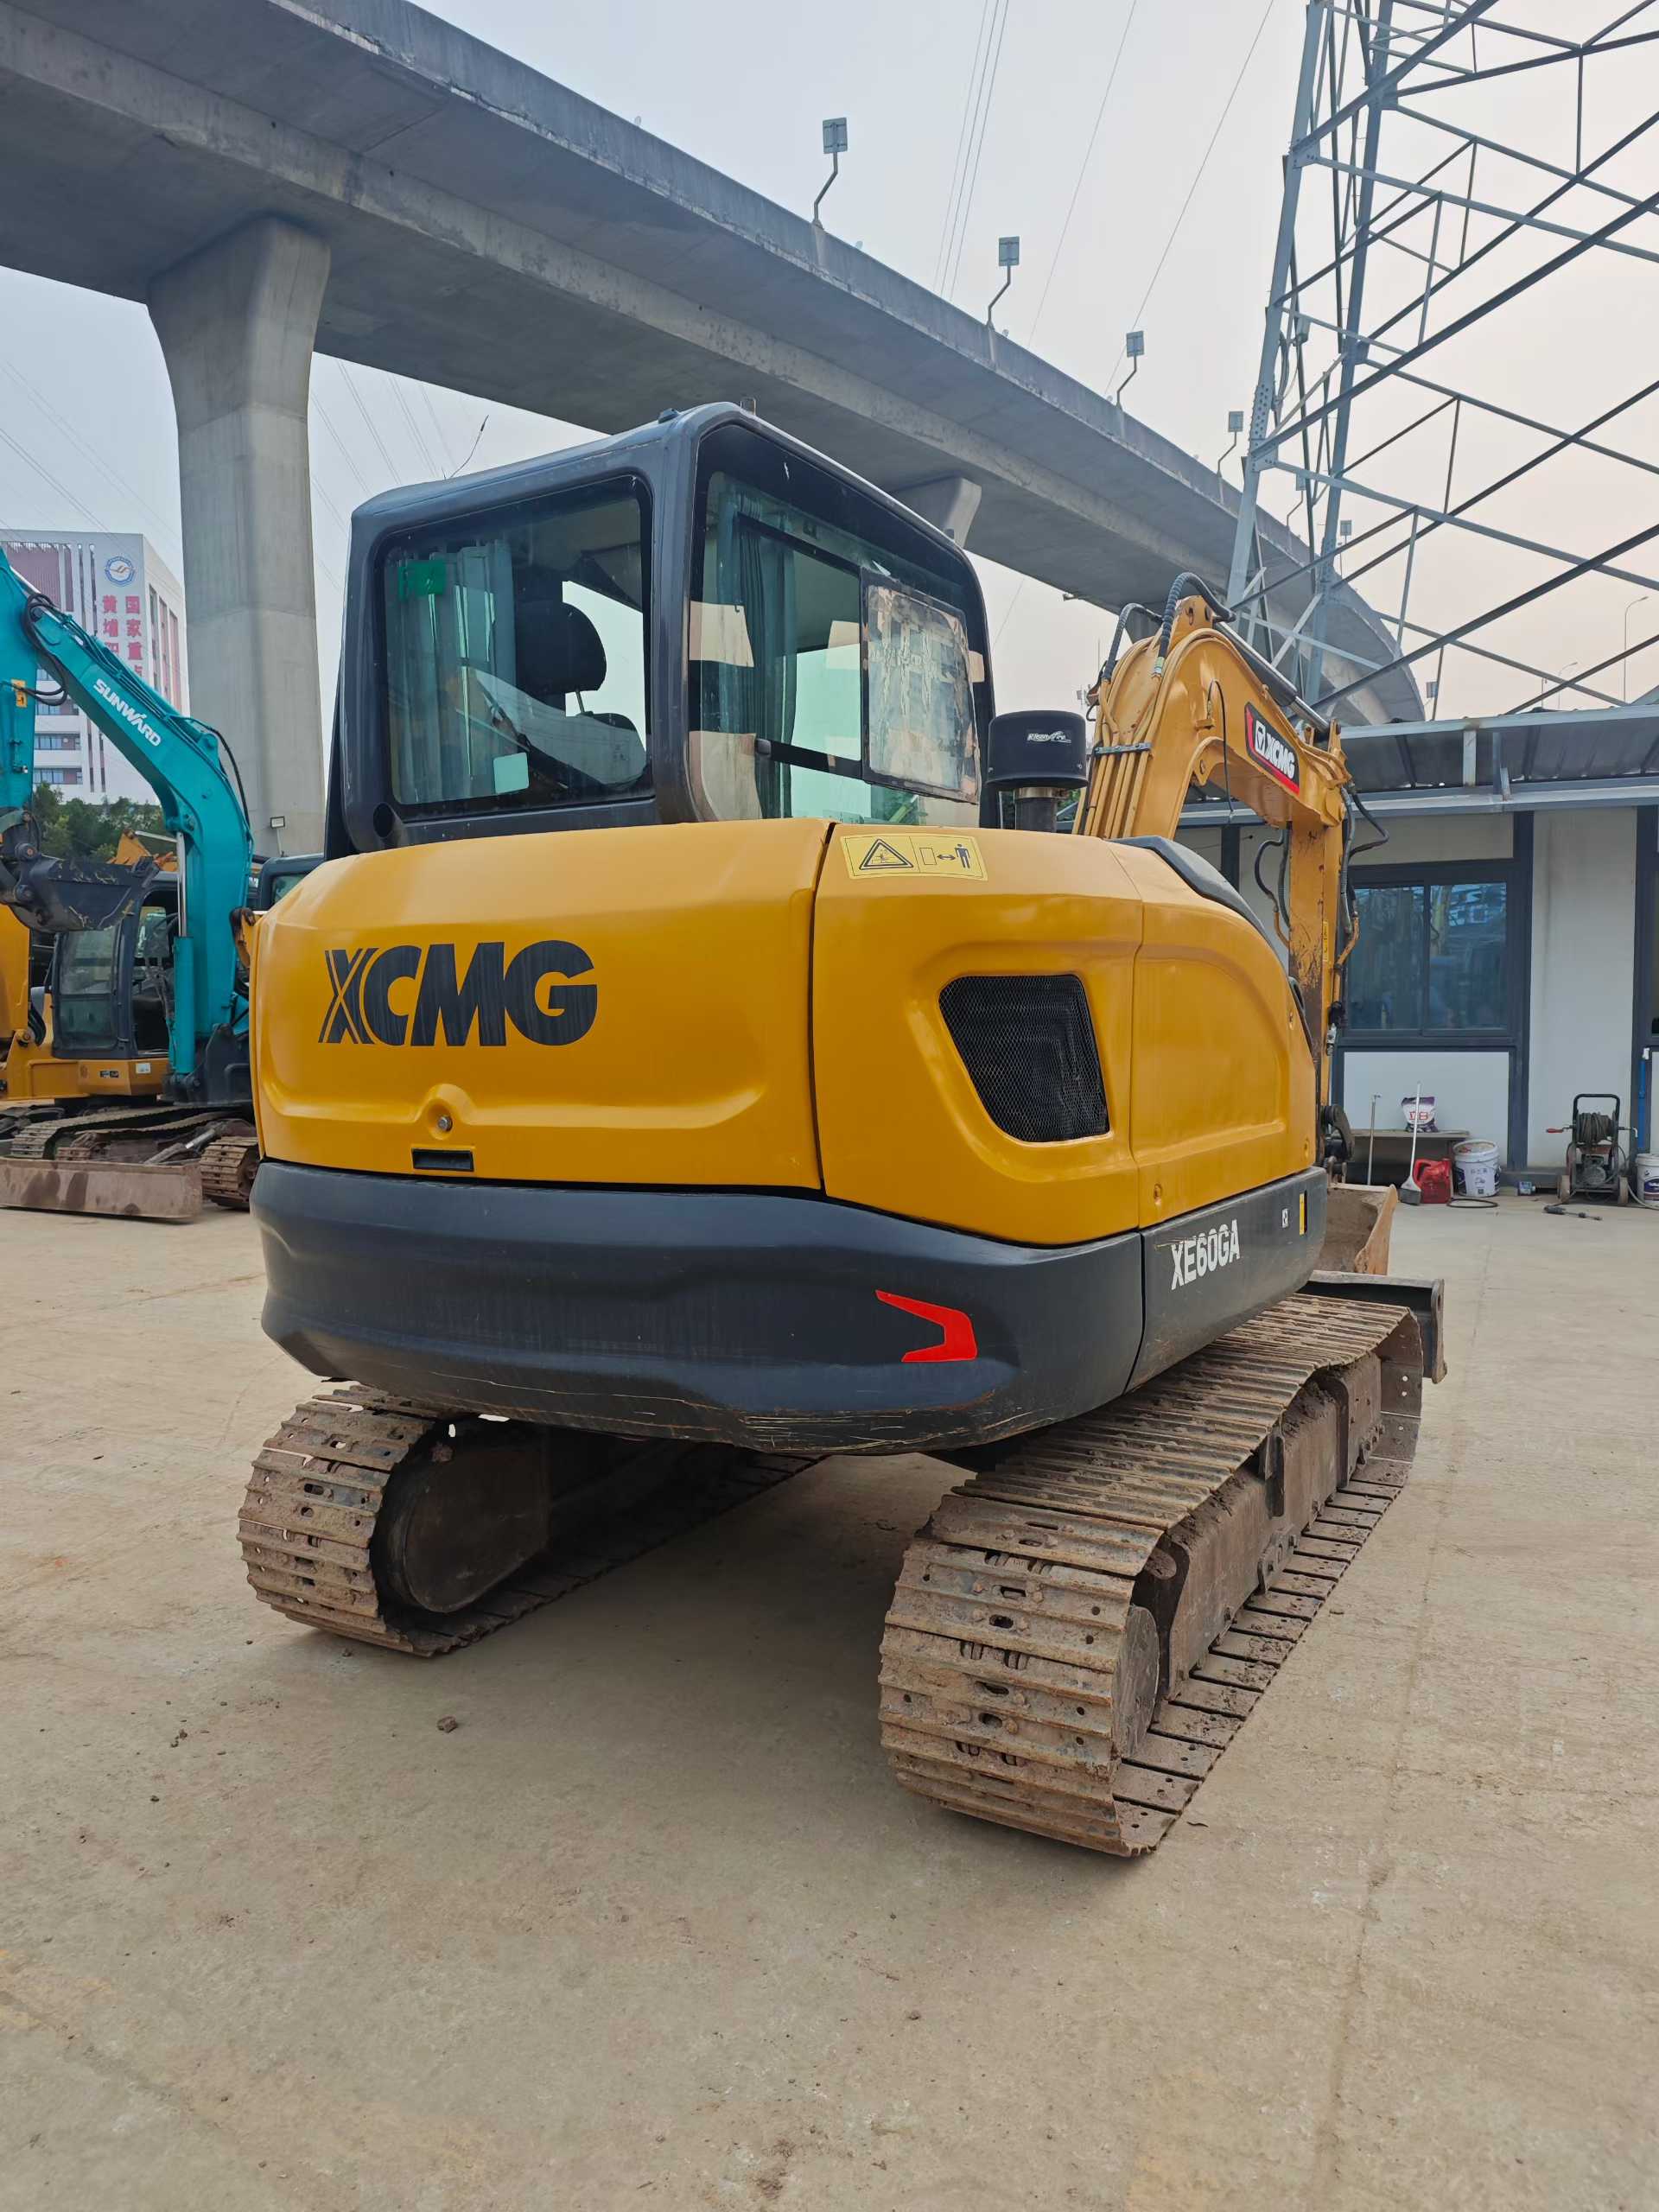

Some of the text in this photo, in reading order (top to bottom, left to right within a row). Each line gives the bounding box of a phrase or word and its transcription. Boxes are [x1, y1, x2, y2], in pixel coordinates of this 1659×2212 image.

[93, 678, 162, 747] SUNWARD
[1265, 732, 1295, 779] XCMG
[318, 940, 598, 1046] XCMG
[1171, 1219, 1241, 1291] XE60GA
